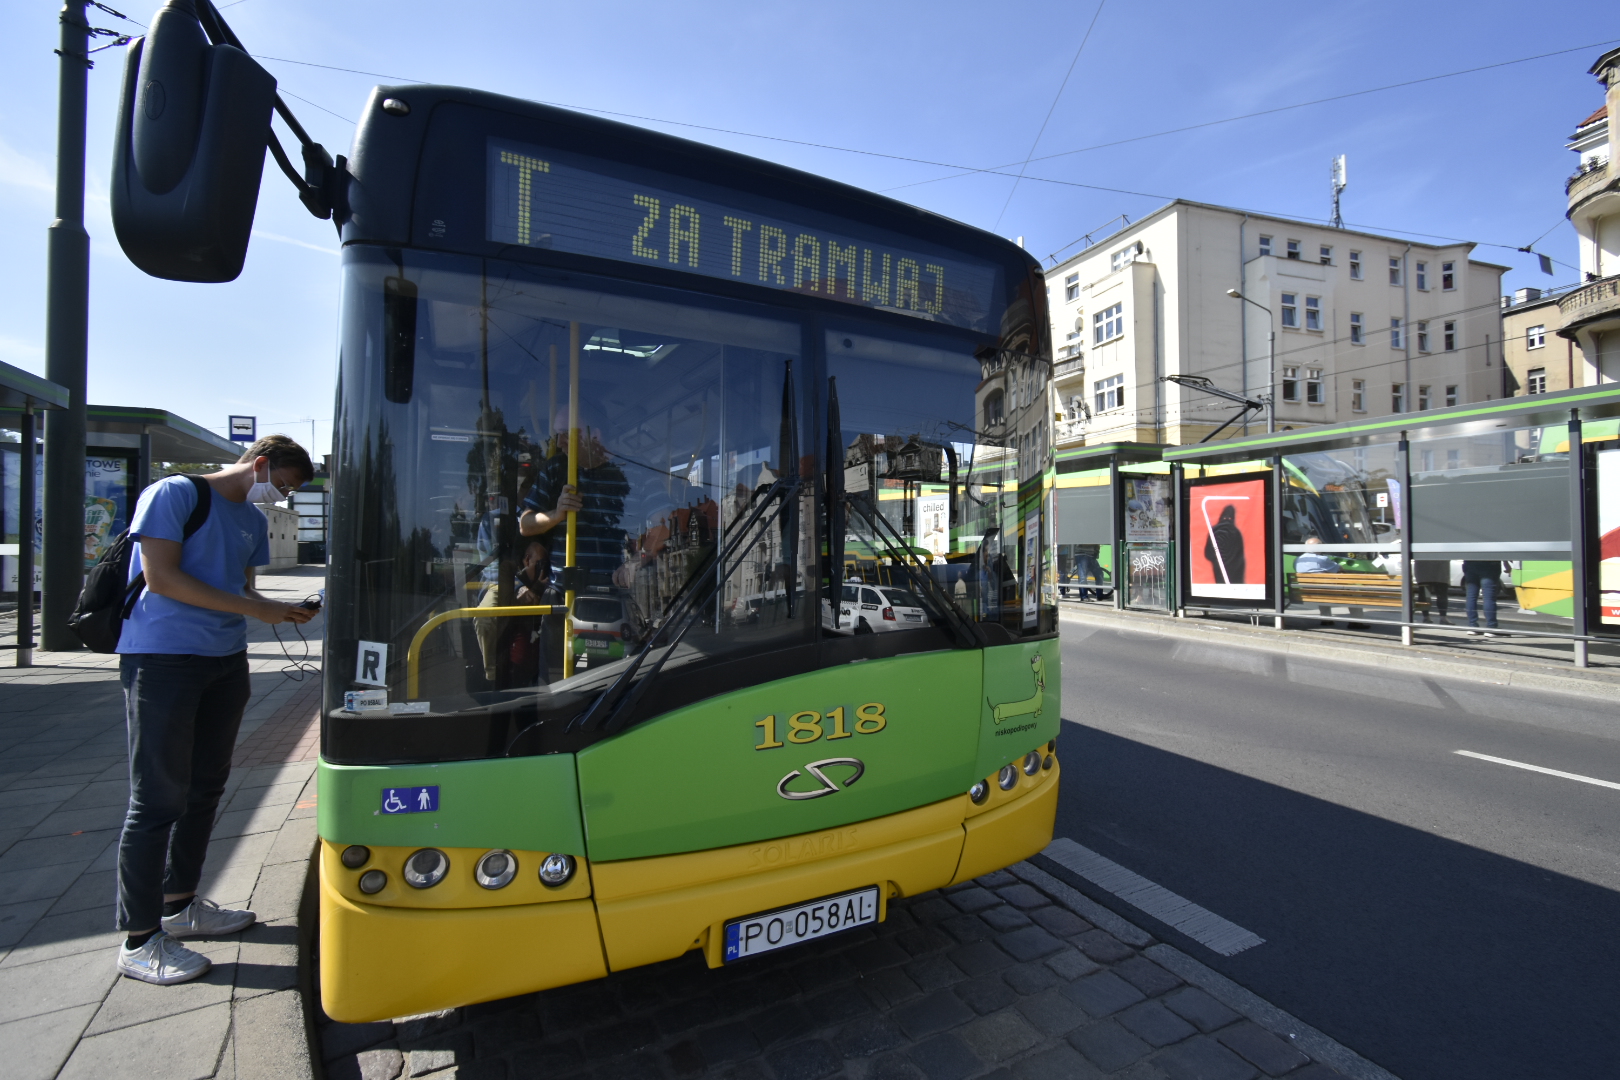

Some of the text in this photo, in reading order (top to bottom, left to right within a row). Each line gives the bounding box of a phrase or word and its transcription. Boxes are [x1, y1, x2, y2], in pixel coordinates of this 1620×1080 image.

[501, 151, 549, 244] T
[632, 194, 944, 315] ZA TRAMWAJ
[86, 460, 121, 469] TOWE
[922, 502, 944, 512] chilled
[362, 650, 379, 681] R
[755, 702, 887, 751] 1818
[748, 828, 858, 870] SOLARIS
[744, 896, 871, 952] PO 058AL
[727, 945, 738, 955] PL
